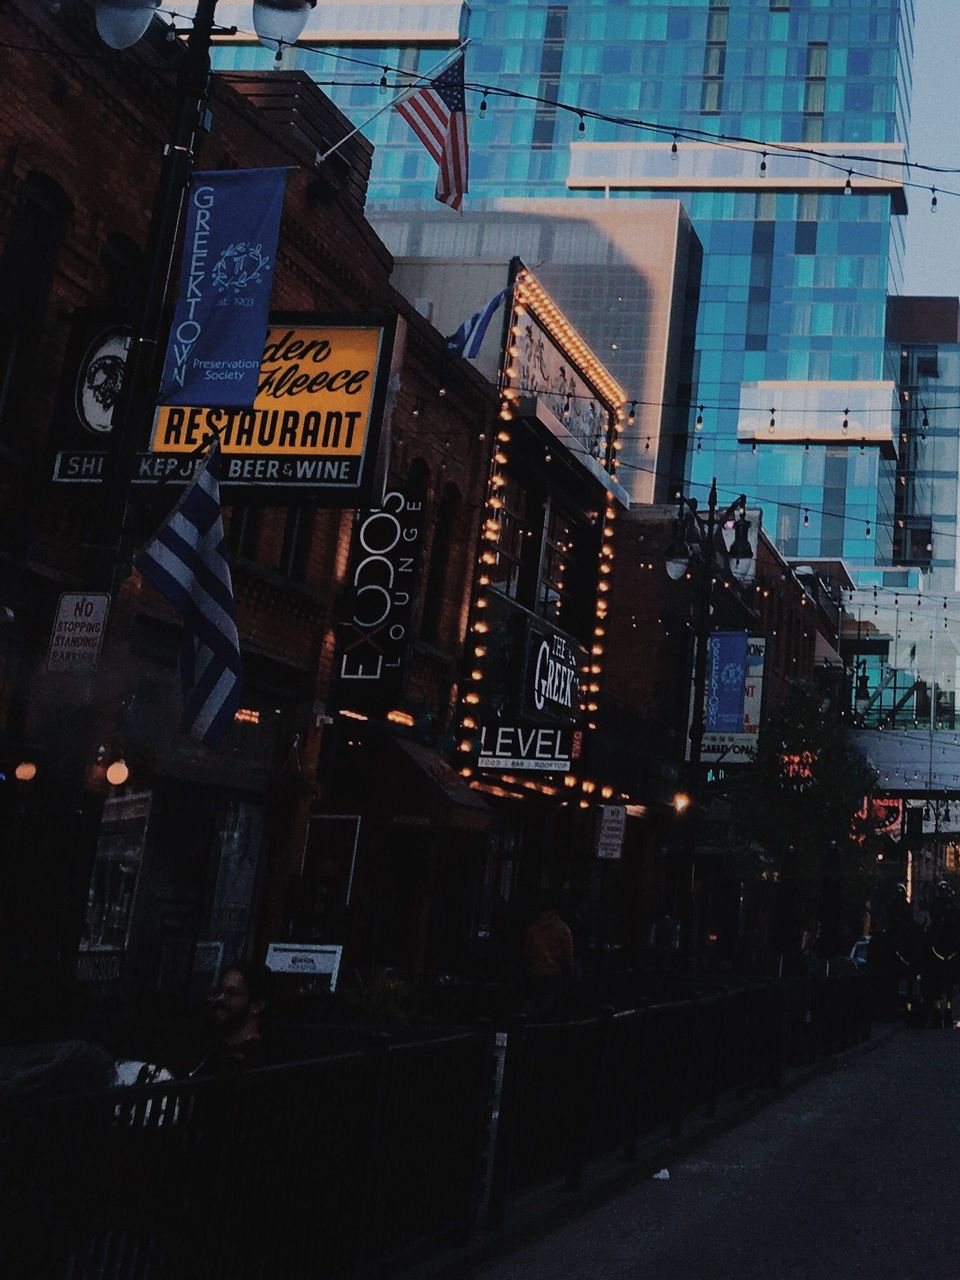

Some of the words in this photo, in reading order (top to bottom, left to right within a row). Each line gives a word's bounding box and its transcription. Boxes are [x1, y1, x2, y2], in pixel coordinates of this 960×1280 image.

[172, 185, 215, 388] GREEKTOWN
[192, 358, 259, 370] Preservation
[204, 369, 246, 382] Society
[163, 407, 361, 449] RESTAURANT
[228, 459, 278, 479] BEER
[282, 462, 292, 478] &
[296, 460, 351, 480] WINE
[385, 500, 422, 668] LOUNGE
[74, 601, 94, 617] NO
[57, 621, 101, 633] STOPPING
[551, 634, 567, 660] THE
[534, 640, 575, 711] GREEK
[480, 726, 569, 759] LEVEL
